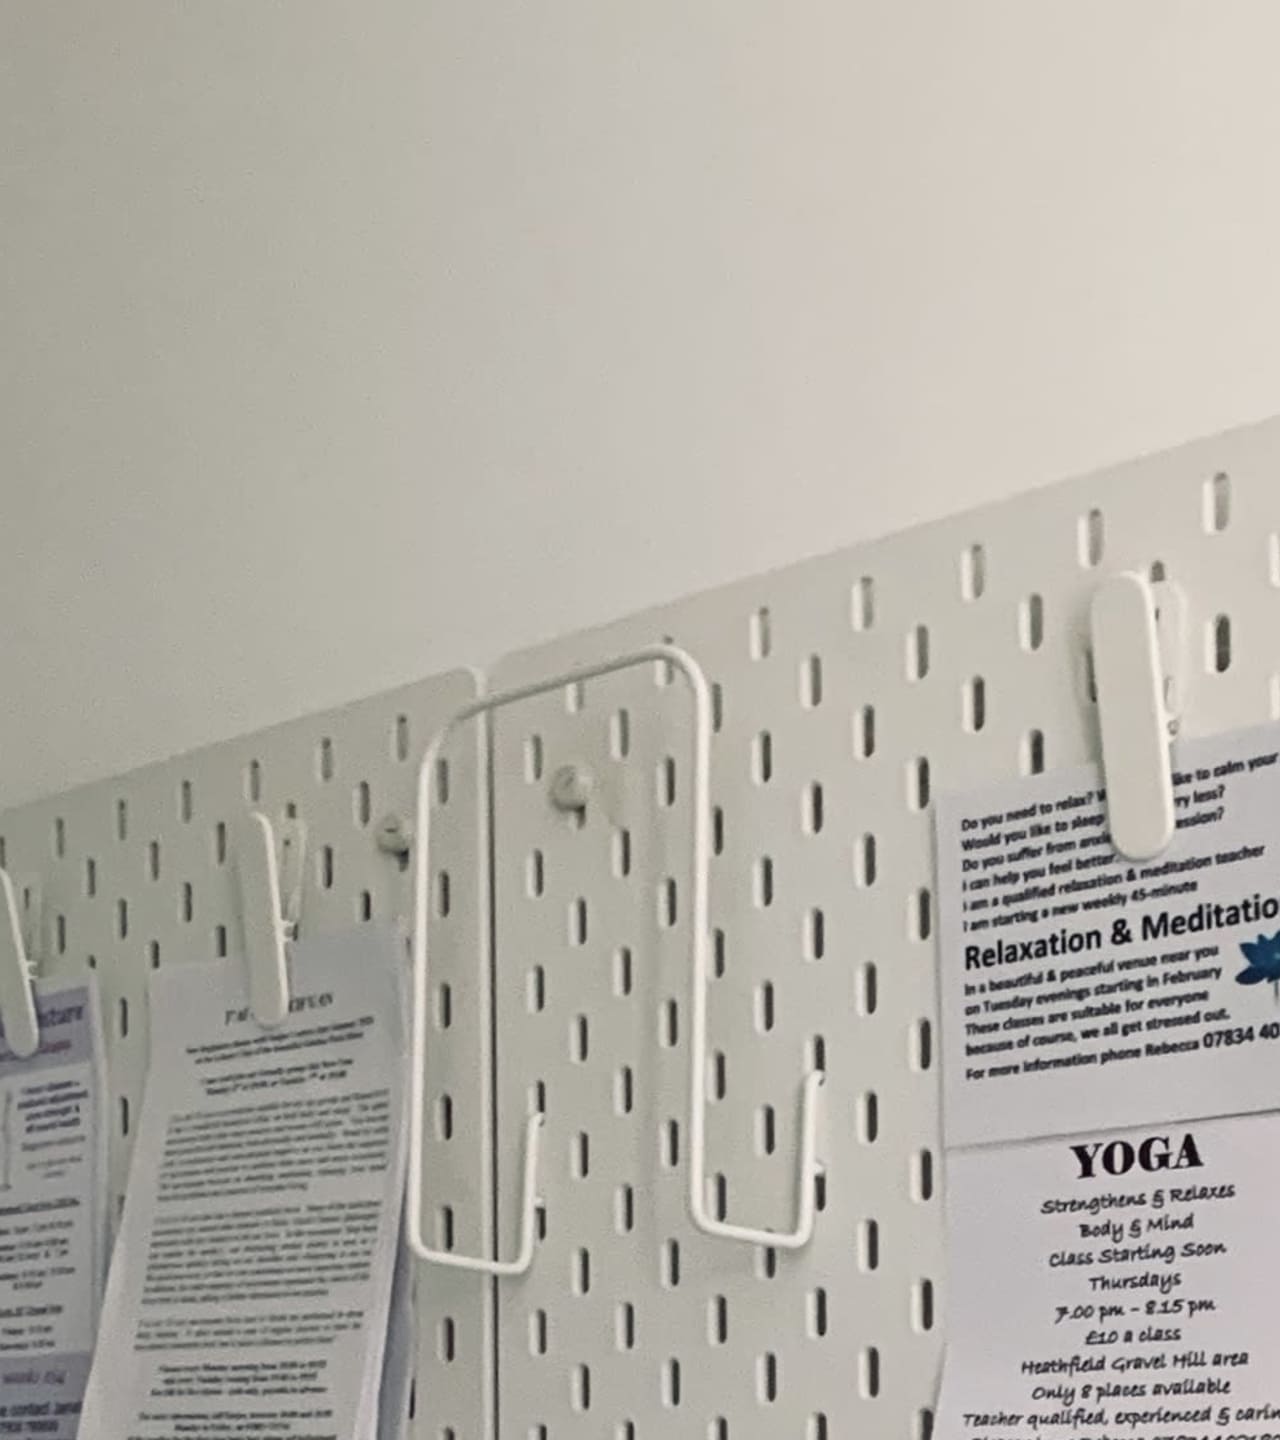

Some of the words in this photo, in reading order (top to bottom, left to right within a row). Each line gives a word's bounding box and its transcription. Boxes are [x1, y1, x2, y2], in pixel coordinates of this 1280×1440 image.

[961, 818, 978, 831] Do
[981, 814, 1003, 830] you
[1006, 805, 1036, 822] need
[1040, 803, 1052, 815] to
[1056, 791, 1093, 811] relax?
[1195, 769, 1210, 781] to
[1214, 760, 1244, 777] calm
[1248, 752, 1279, 772] your
[961, 833, 1001, 850] Would
[1005, 830, 1026, 845] you
[1030, 824, 1051, 837] like
[1055, 821, 1068, 832] to
[1071, 814, 1105, 830] sleep
[1194, 784, 1225, 804] less?
[962, 859, 978, 871] Do
[982, 855, 1004, 870] you
[1008, 845, 1043, 863] suffer
[1046, 842, 1076, 855] from
[963, 880, 967, 891] I
[970, 878, 990, 891] can
[993, 871, 1020, 886] help
[1024, 867, 1045, 882] you
[1049, 859, 1072, 876] feel
[963, 902, 967, 912] I
[970, 899, 988, 910] am
[992, 897, 998, 906] a
[1002, 884, 1055, 906] qualified
[1059, 873, 1122, 894] relaxation
[1126, 868, 1136, 881] &
[1141, 856, 1212, 880] meditation
[1215, 845, 1265, 865] teacher
[963, 921, 967, 931] I
[971, 918, 990, 929] am
[992, 909, 1039, 927] starting
[1042, 909, 1048, 918] a
[1052, 903, 1079, 917] new
[1082, 893, 1127, 910] weekly
[1131, 880, 1198, 901] 45-minute
[965, 929, 1101, 970] Relaxation
[1111, 918, 1133, 946] &
[965, 984, 975, 996] In
[979, 984, 985, 993] a
[989, 972, 1043, 991] beautiful
[1047, 970, 1056, 982] &
[1060, 960, 1114, 982] peaceful
[1118, 955, 1157, 970] venue
[1161, 949, 1190, 964] near
[1195, 946, 1219, 962] you
[965, 1004, 980, 1016] on
[983, 996, 1033, 1012] Tuesday
[1036, 986, 1091, 1005] evenings
[1094, 977, 1143, 996] starting
[1147, 975, 1159, 987] in
[1163, 966, 1222, 985] February
[965, 1022, 1000, 1035] These
[1003, 1017, 1044, 1030] classes
[1048, 1012, 1067, 1022] are
[1072, 1002, 1121, 1020] suitable
[1126, 999, 1144, 1011] for
[1147, 990, 1208, 1011] everyone
[966, 1040, 1013, 1056] because
[1017, 1035, 1030, 1047] of
[1033, 1032, 1077, 1046] course,
[1081, 1027, 1099, 1039] we
[1103, 1022, 1118, 1036] all
[1121, 1019, 1142, 1036] get
[1146, 1010, 1201, 1030] stressed
[1204, 1008, 1230, 1022] out.
[966, 1069, 985, 1080] For
[989, 1065, 1019, 1077] more
[1024, 1053, 1097, 1072] information
[1100, 1046, 1141, 1064] phone
[1145, 1039, 1199, 1057] Rebecca
[1203, 1026, 1255, 1049] 07834
[1069, 1133, 1204, 1179] YOGA
[1041, 1192, 1147, 1215] Strengthens
[1170, 1184, 1235, 1203] Relaxes
[1080, 1220, 1124, 1243] Body
[1148, 1213, 1194, 1232] Mind
[1049, 1251, 1093, 1268] Class
[1098, 1244, 1175, 1264] Starting
[1181, 1242, 1227, 1257] Soon
[1089, 1272, 1182, 1293] Thursdays
[1055, 1305, 1094, 1324] 7.00
[1099, 1305, 1125, 1323] pm
[1145, 1299, 1185, 1315] 8.15
[1188, 1299, 1216, 1318] pm
[1085, 1330, 1118, 1345] £10
[1124, 1330, 1133, 1343] a
[1139, 1326, 1181, 1342] class
[1022, 1355, 1106, 1376] Heathfield
[1111, 1353, 1167, 1372] Gravel
[1173, 1351, 1206, 1368] Hill
[1212, 1352, 1248, 1367] area
[1032, 1384, 1075, 1406] Only
[1081, 1384, 1092, 1398] 8
[1096, 1382, 1146, 1404] places
[1152, 1378, 1231, 1395] available
[963, 1411, 1023, 1427] Teacher
[1027, 1408, 1109, 1430] qualified,
[1115, 1406, 1211, 1429] experienced
